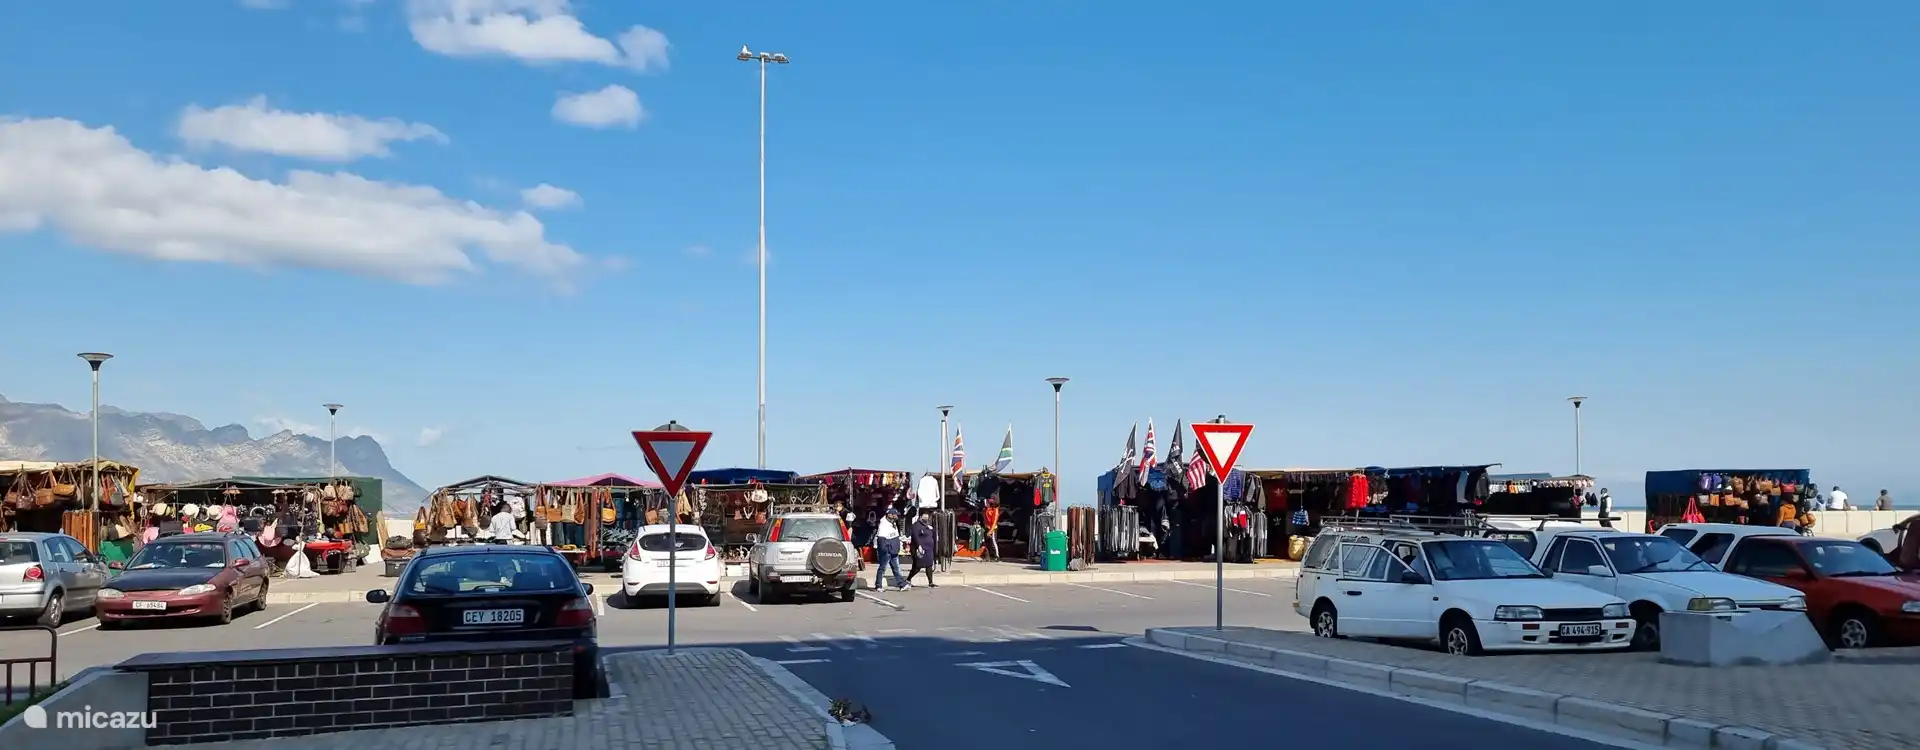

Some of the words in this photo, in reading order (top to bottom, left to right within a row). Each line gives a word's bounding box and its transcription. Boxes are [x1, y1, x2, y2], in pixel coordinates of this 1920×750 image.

[465, 611, 485, 622] CEY
[491, 610, 521, 622] 18205
[1561, 626, 1570, 635] CA
